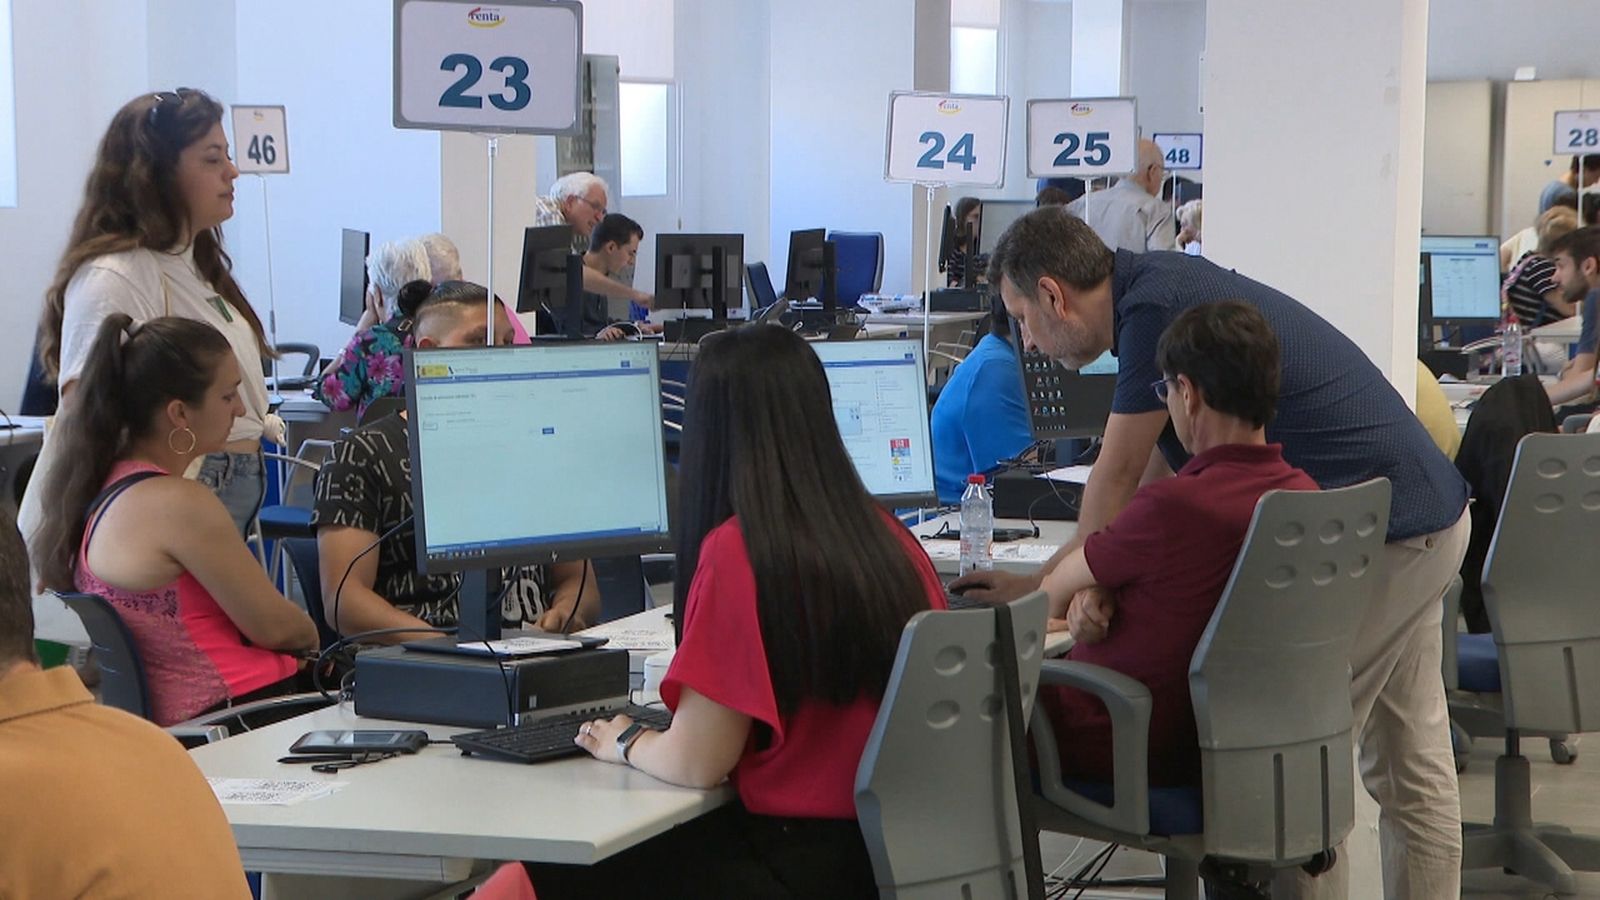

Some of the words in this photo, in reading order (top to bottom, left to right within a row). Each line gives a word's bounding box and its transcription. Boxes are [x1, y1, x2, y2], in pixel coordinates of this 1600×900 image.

[468, 9, 500, 22] renta
[438, 54, 532, 111] 23
[247, 134, 276, 165] 46
[916, 132, 977, 171] 24
[1053, 132, 1111, 167] 25
[1569, 128, 1598, 147] 28
[1165, 148, 1190, 164] 48
